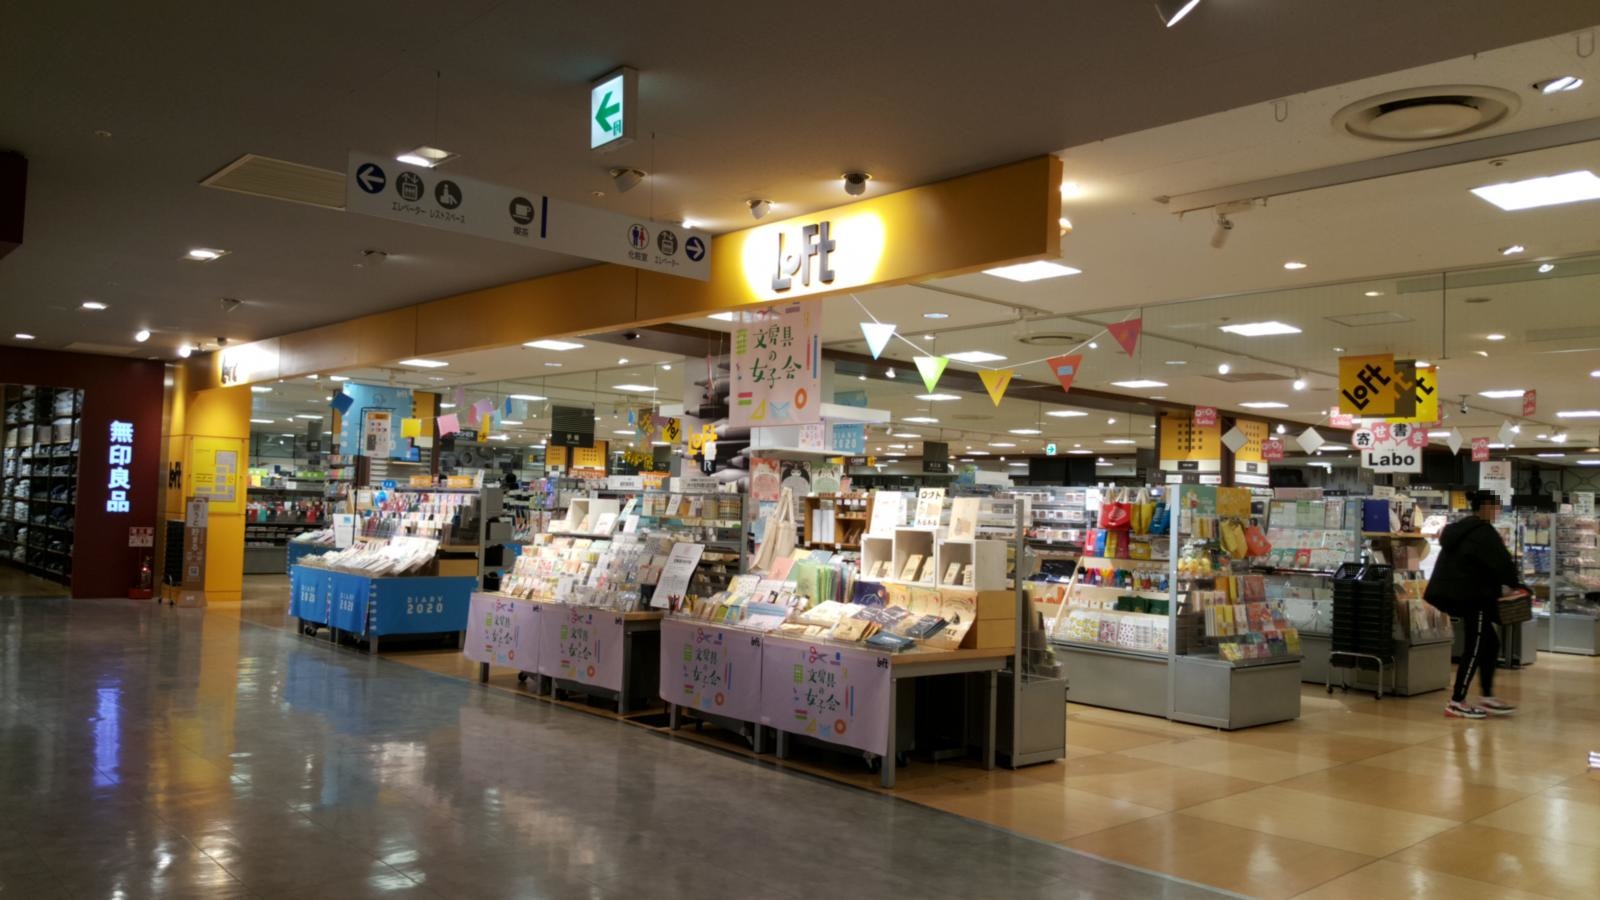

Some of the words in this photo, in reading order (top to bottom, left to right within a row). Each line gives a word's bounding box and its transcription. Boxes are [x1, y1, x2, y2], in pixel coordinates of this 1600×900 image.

[752, 323, 794, 349] 文房具
[769, 350, 777, 361] の
[749, 355, 802, 389] 女子会
[107, 420, 134, 512] 無印良品
[1368, 452, 1415, 467] Labo
[407, 595, 444, 604] DIARY
[407, 603, 443, 615] 2020
